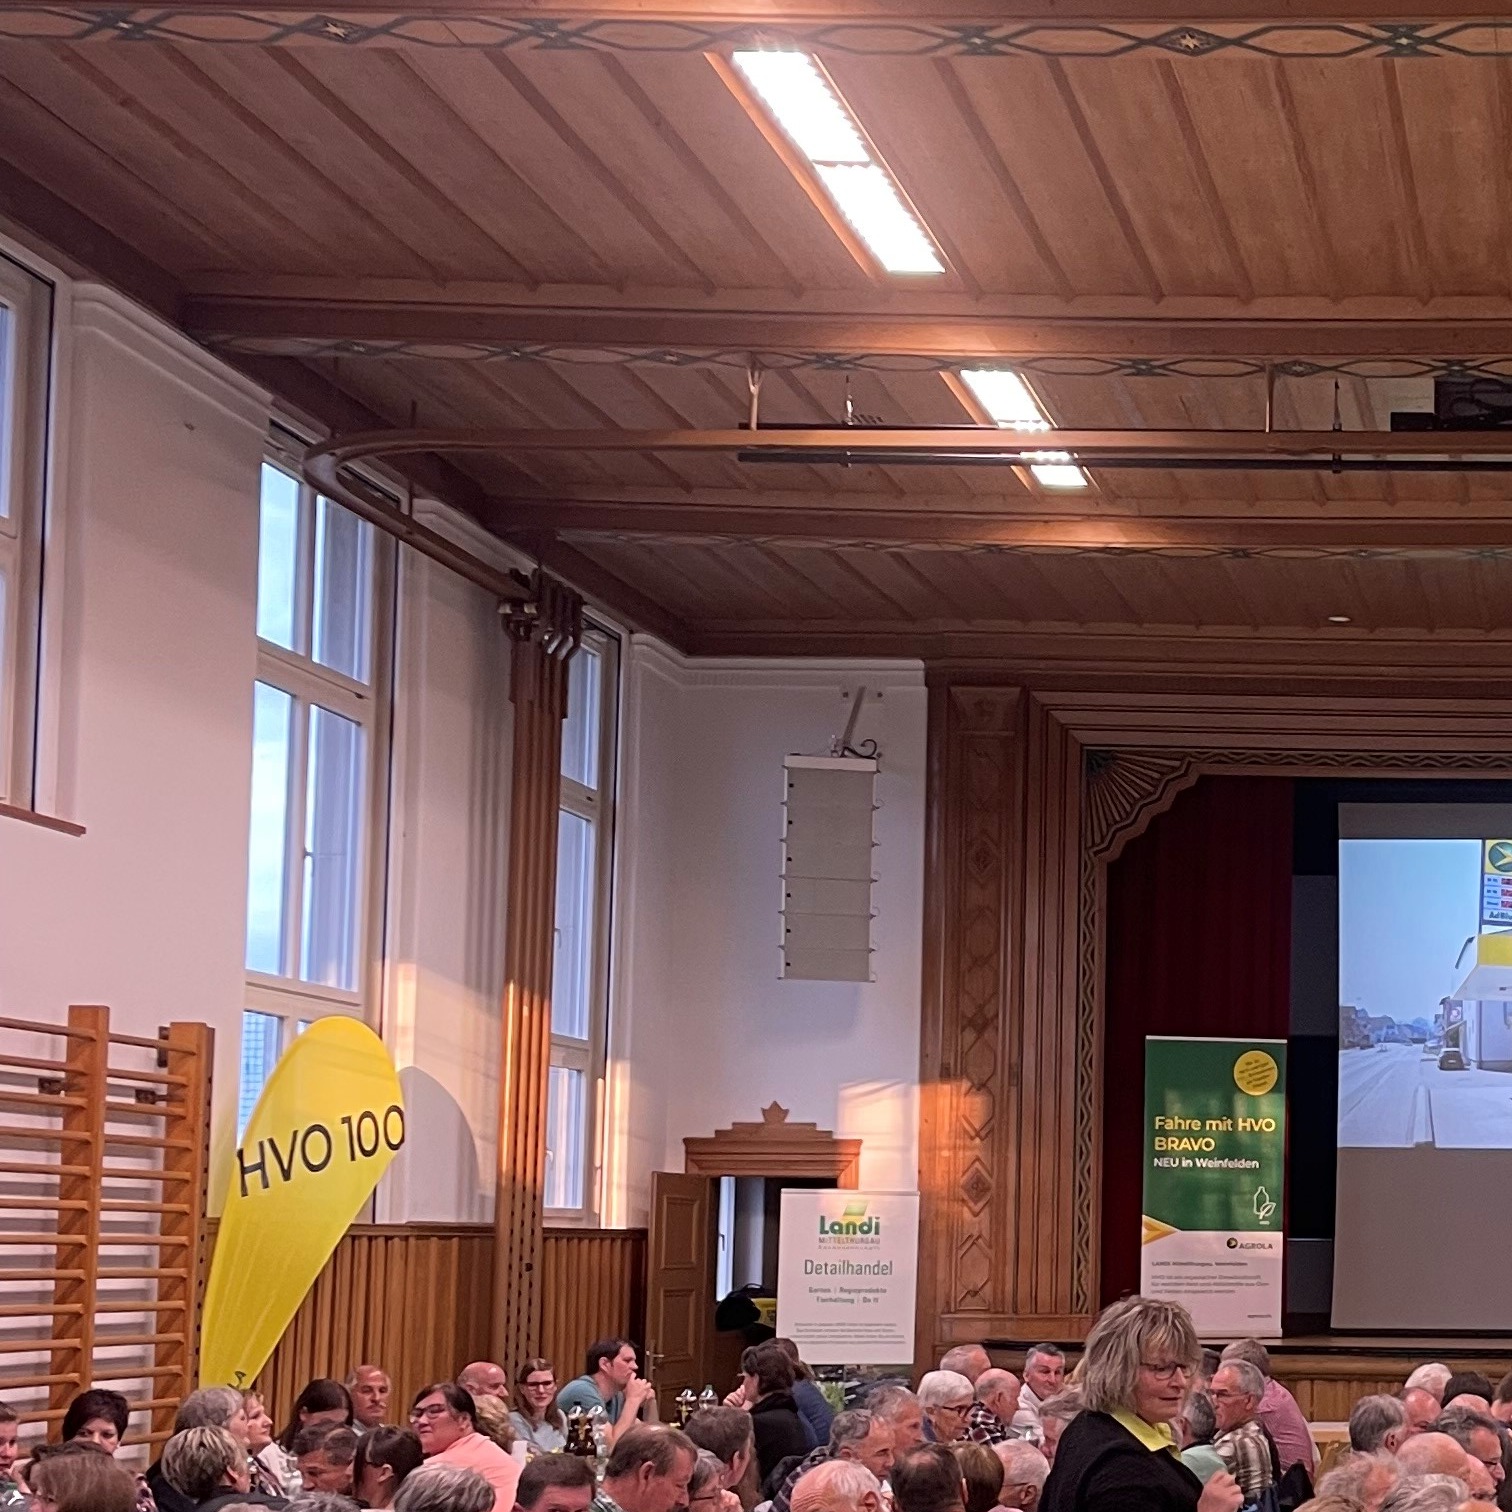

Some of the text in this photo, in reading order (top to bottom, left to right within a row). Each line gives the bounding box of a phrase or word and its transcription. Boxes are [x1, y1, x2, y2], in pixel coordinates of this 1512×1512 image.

[1154, 1116, 1276, 1132] Fahre mit HVO
[237, 1105, 405, 1197] HVO 100
[1154, 1136, 1216, 1152] BRAVO
[1153, 1156, 1260, 1169] NEU in Weinfelden
[819, 1215, 880, 1235] Landi
[1239, 1242, 1274, 1250] AGROLA
[804, 1258, 893, 1276] Detailhandel
